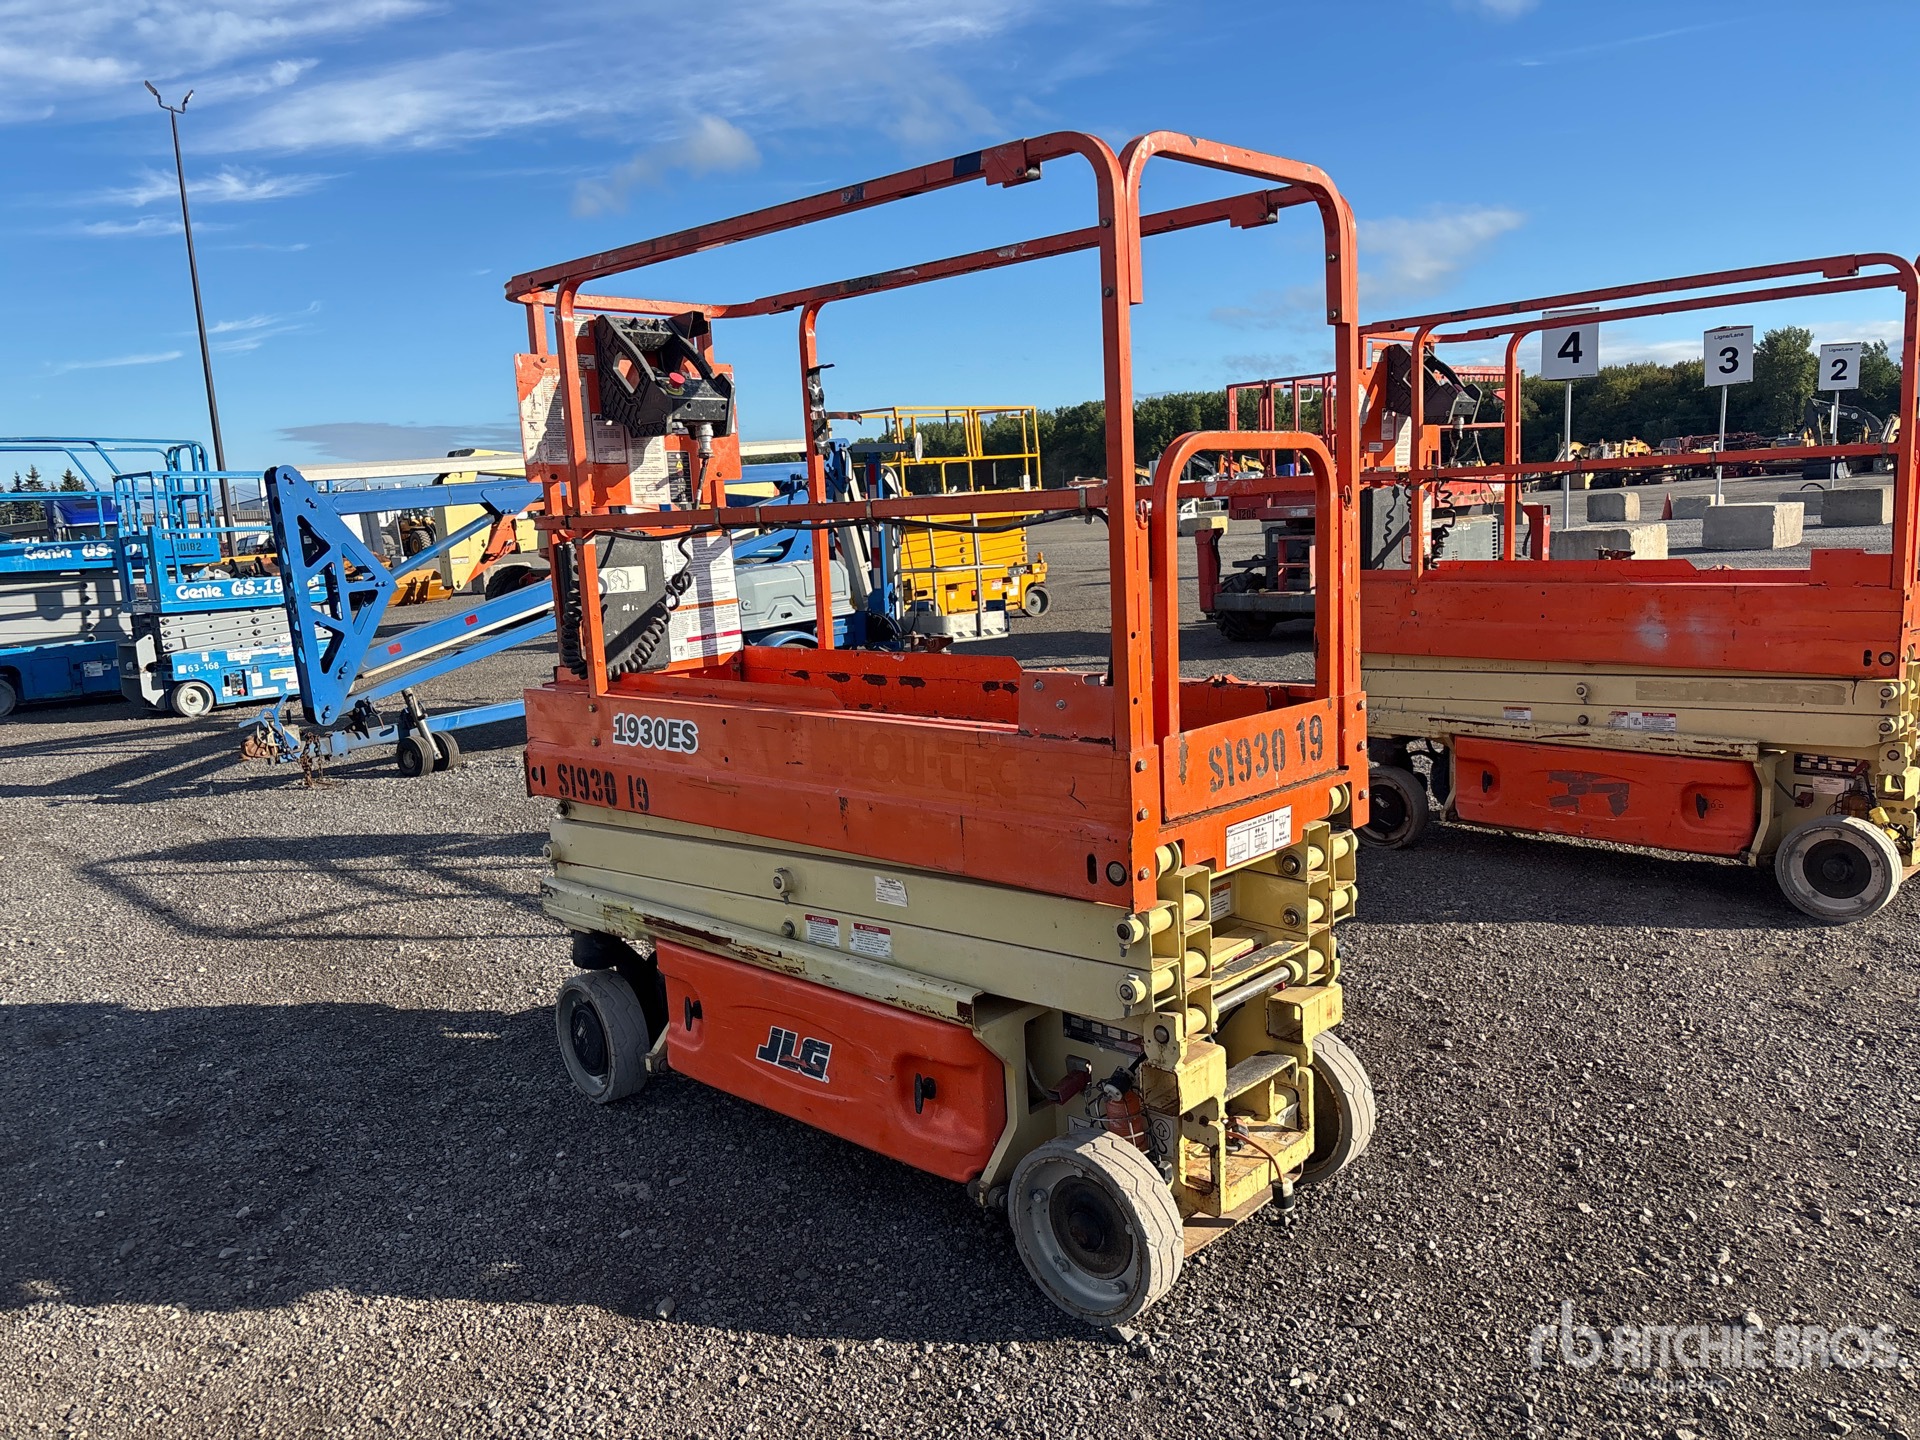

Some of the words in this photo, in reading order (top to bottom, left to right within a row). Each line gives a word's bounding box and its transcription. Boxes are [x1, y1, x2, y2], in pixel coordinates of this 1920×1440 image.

[1558, 331, 1583, 364] 4
[1713, 332, 1744, 340] Ligne/Lane
[1718, 346, 1739, 374] 3
[1830, 358, 1848, 381] 2
[23, 544, 73, 560] Genie
[187, 662, 220, 673] 63-168
[613, 714, 698, 752] 1930ES
[1208, 728, 1286, 793] S1930
[1295, 714, 1324, 764] 19
[557, 763, 618, 807] S1930
[627, 774, 650, 812] 19
[756, 1026, 832, 1082] JLG
